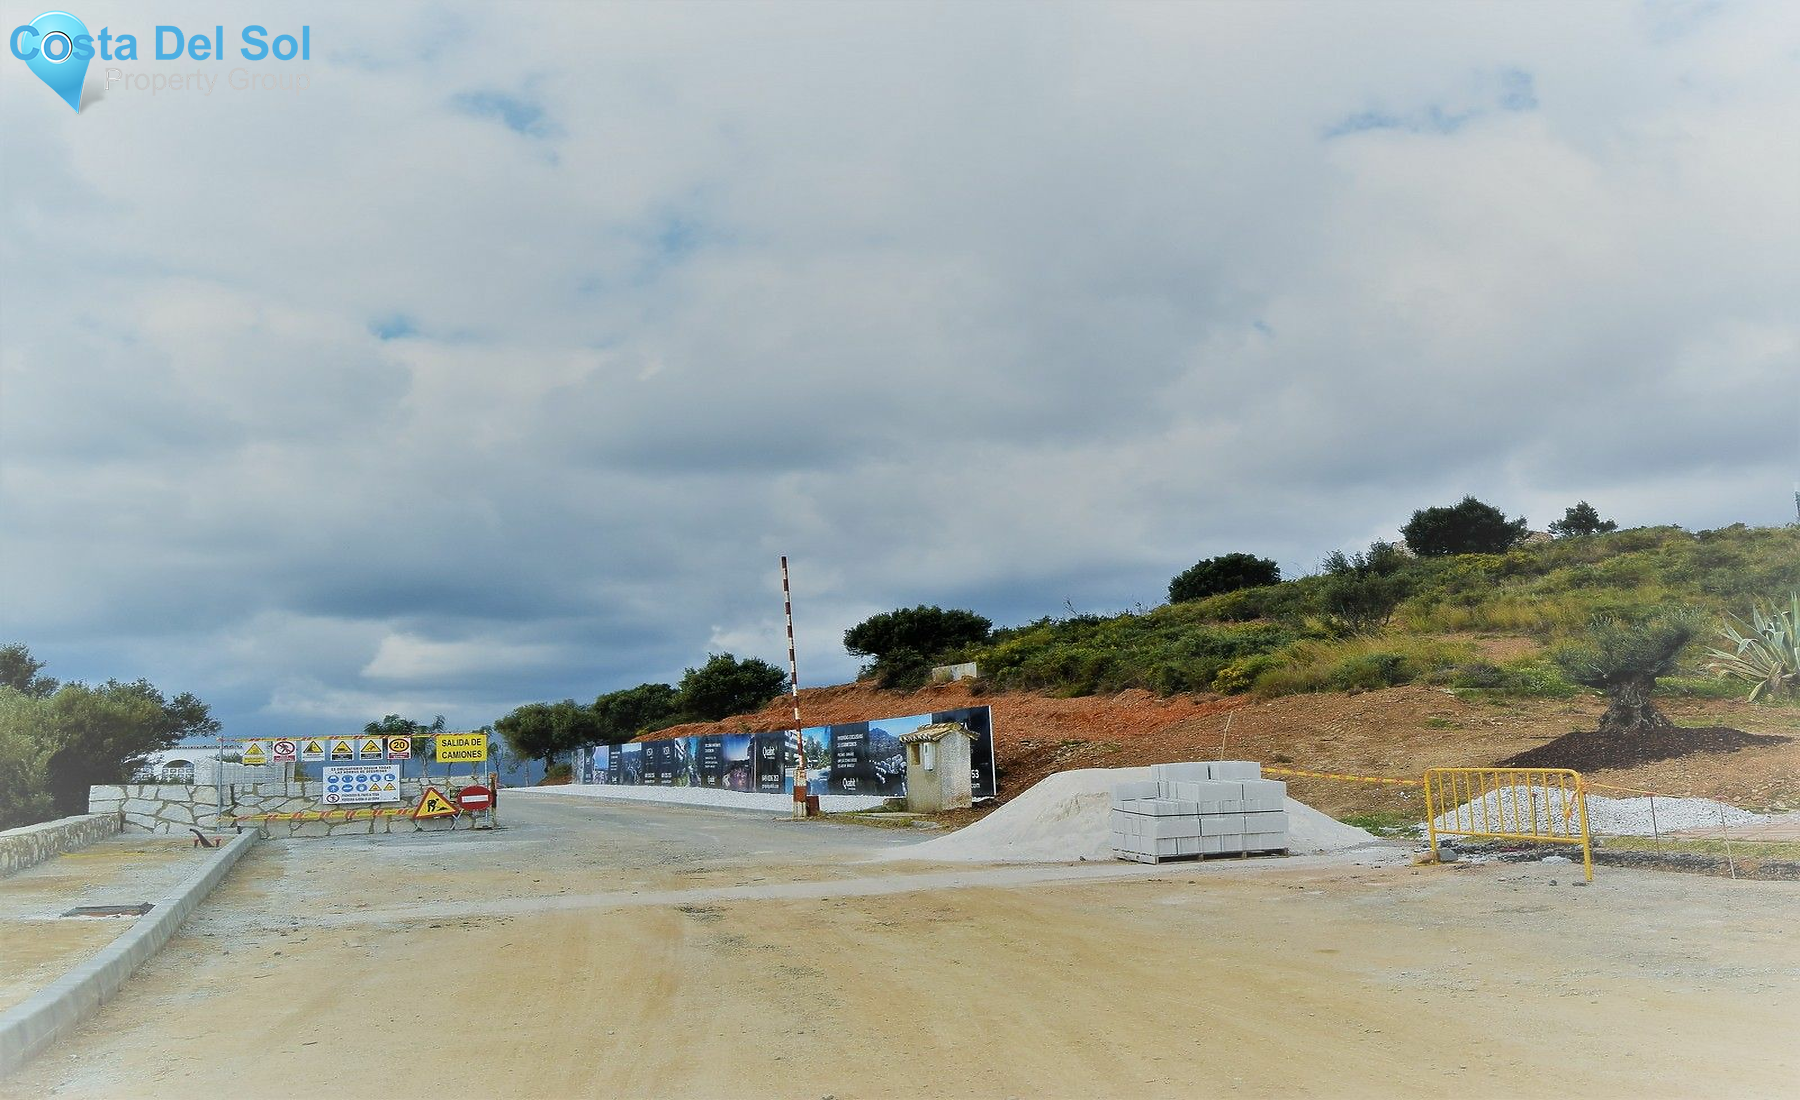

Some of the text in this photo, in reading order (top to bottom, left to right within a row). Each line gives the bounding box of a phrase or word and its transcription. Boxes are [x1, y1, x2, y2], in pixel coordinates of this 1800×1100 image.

[441, 738, 482, 747] SALIDA DE
[441, 750, 483, 759] CAMIONES
